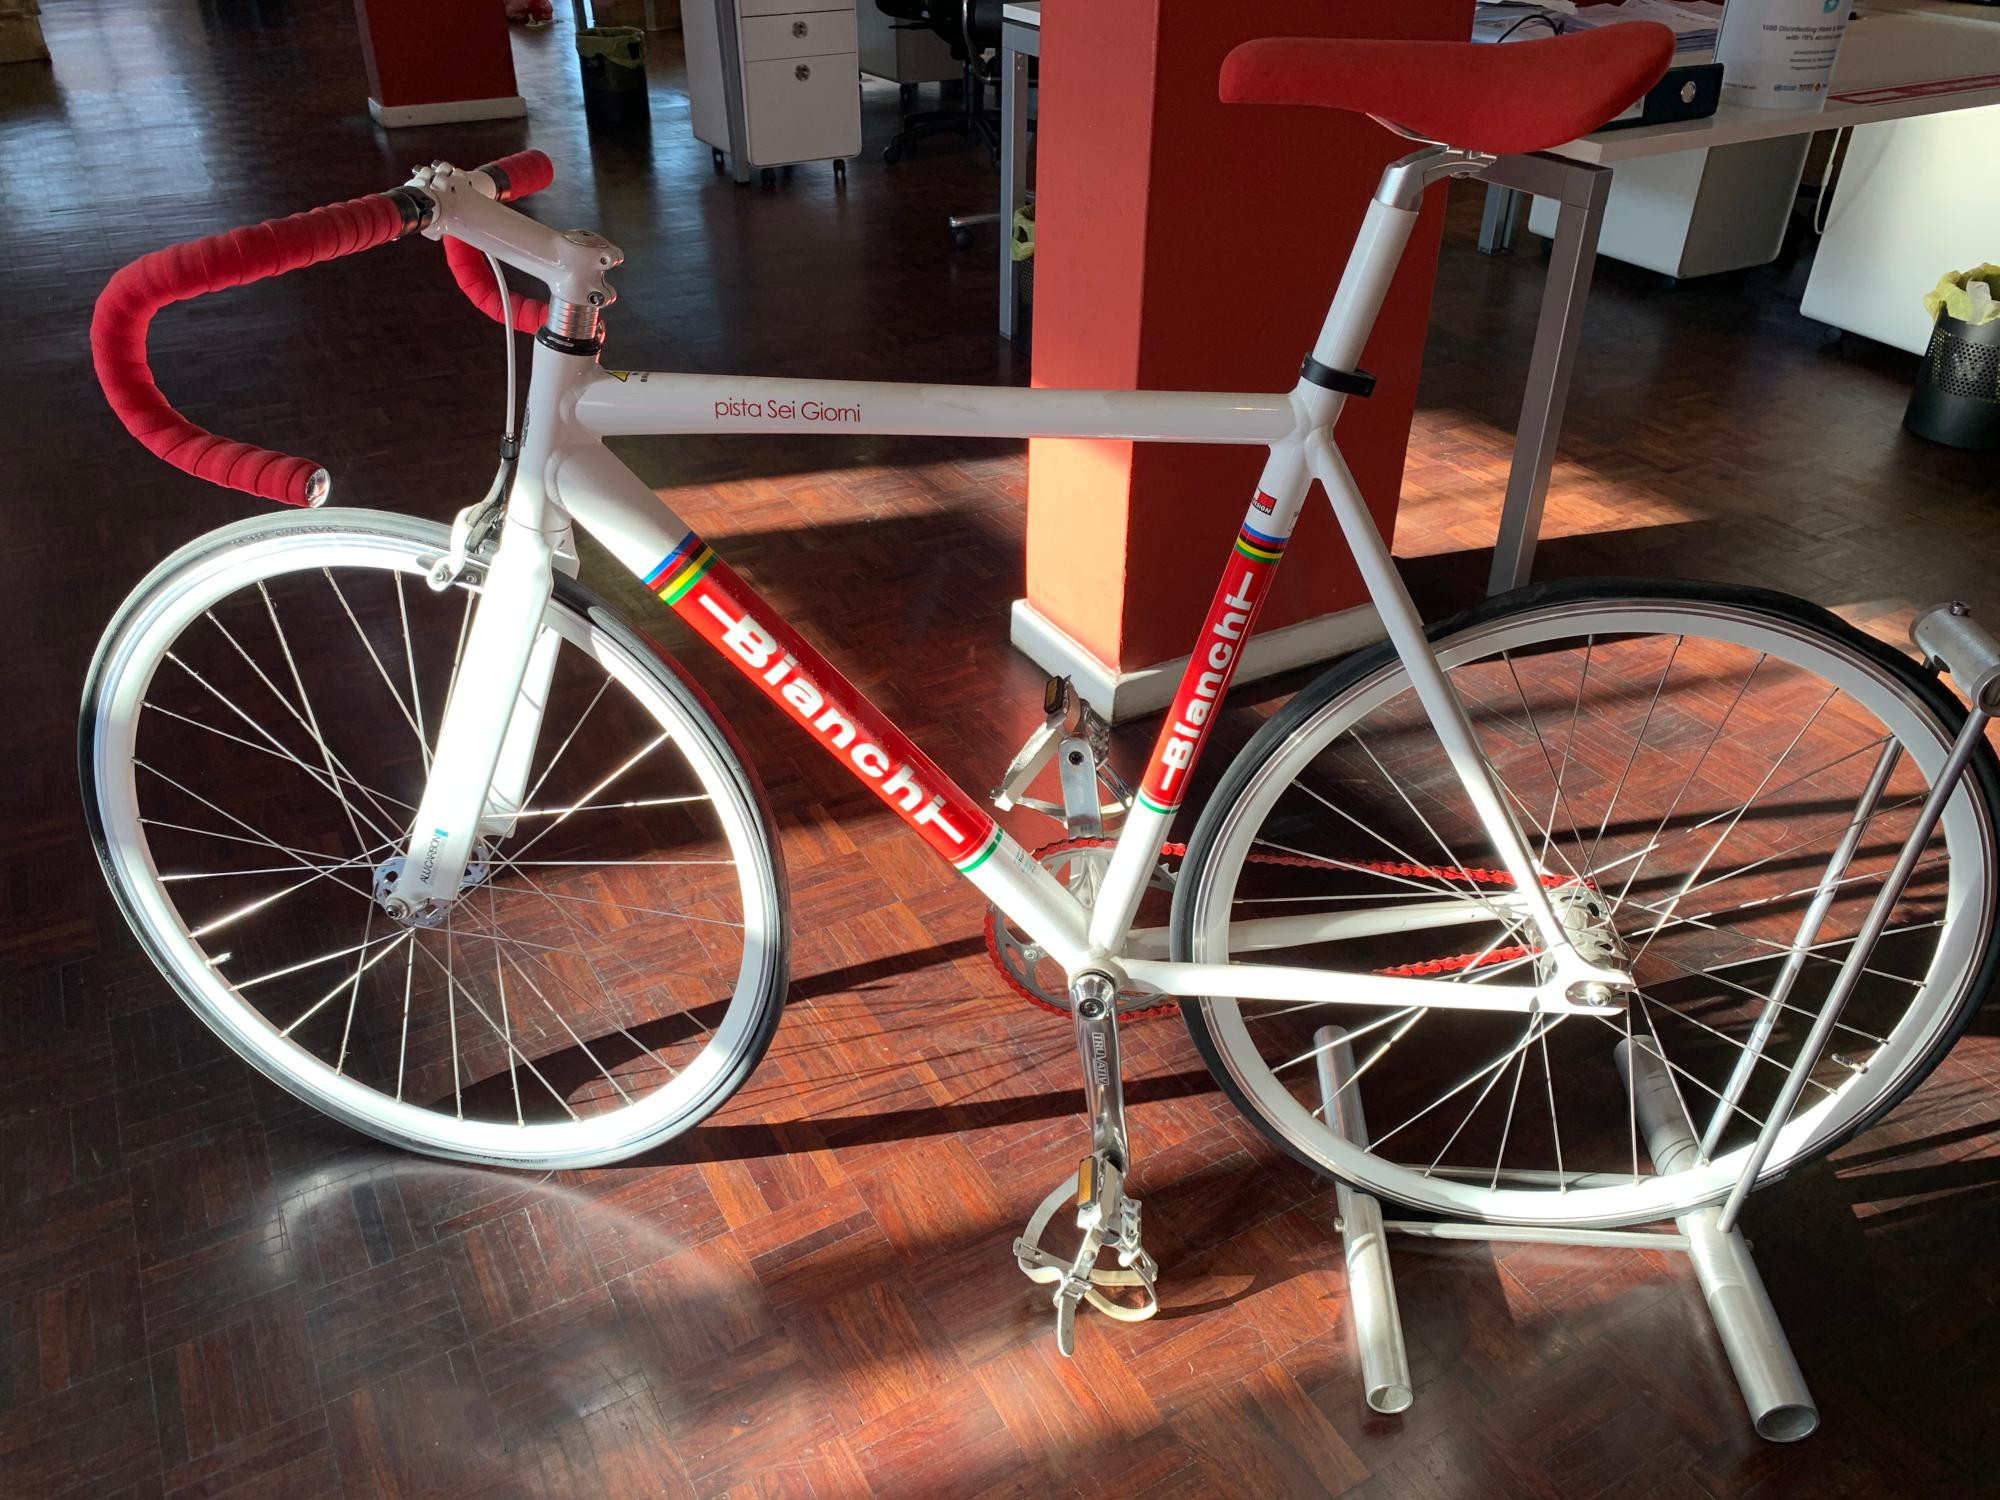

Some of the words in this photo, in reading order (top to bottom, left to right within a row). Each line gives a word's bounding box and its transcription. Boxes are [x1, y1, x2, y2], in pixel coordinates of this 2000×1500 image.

[714, 397, 762, 419] pista
[767, 400, 795, 419] Sei
[801, 401, 861, 422] Giorni
[698, 594, 965, 844] Bianchi
[1161, 571, 1254, 790] Bianchi
